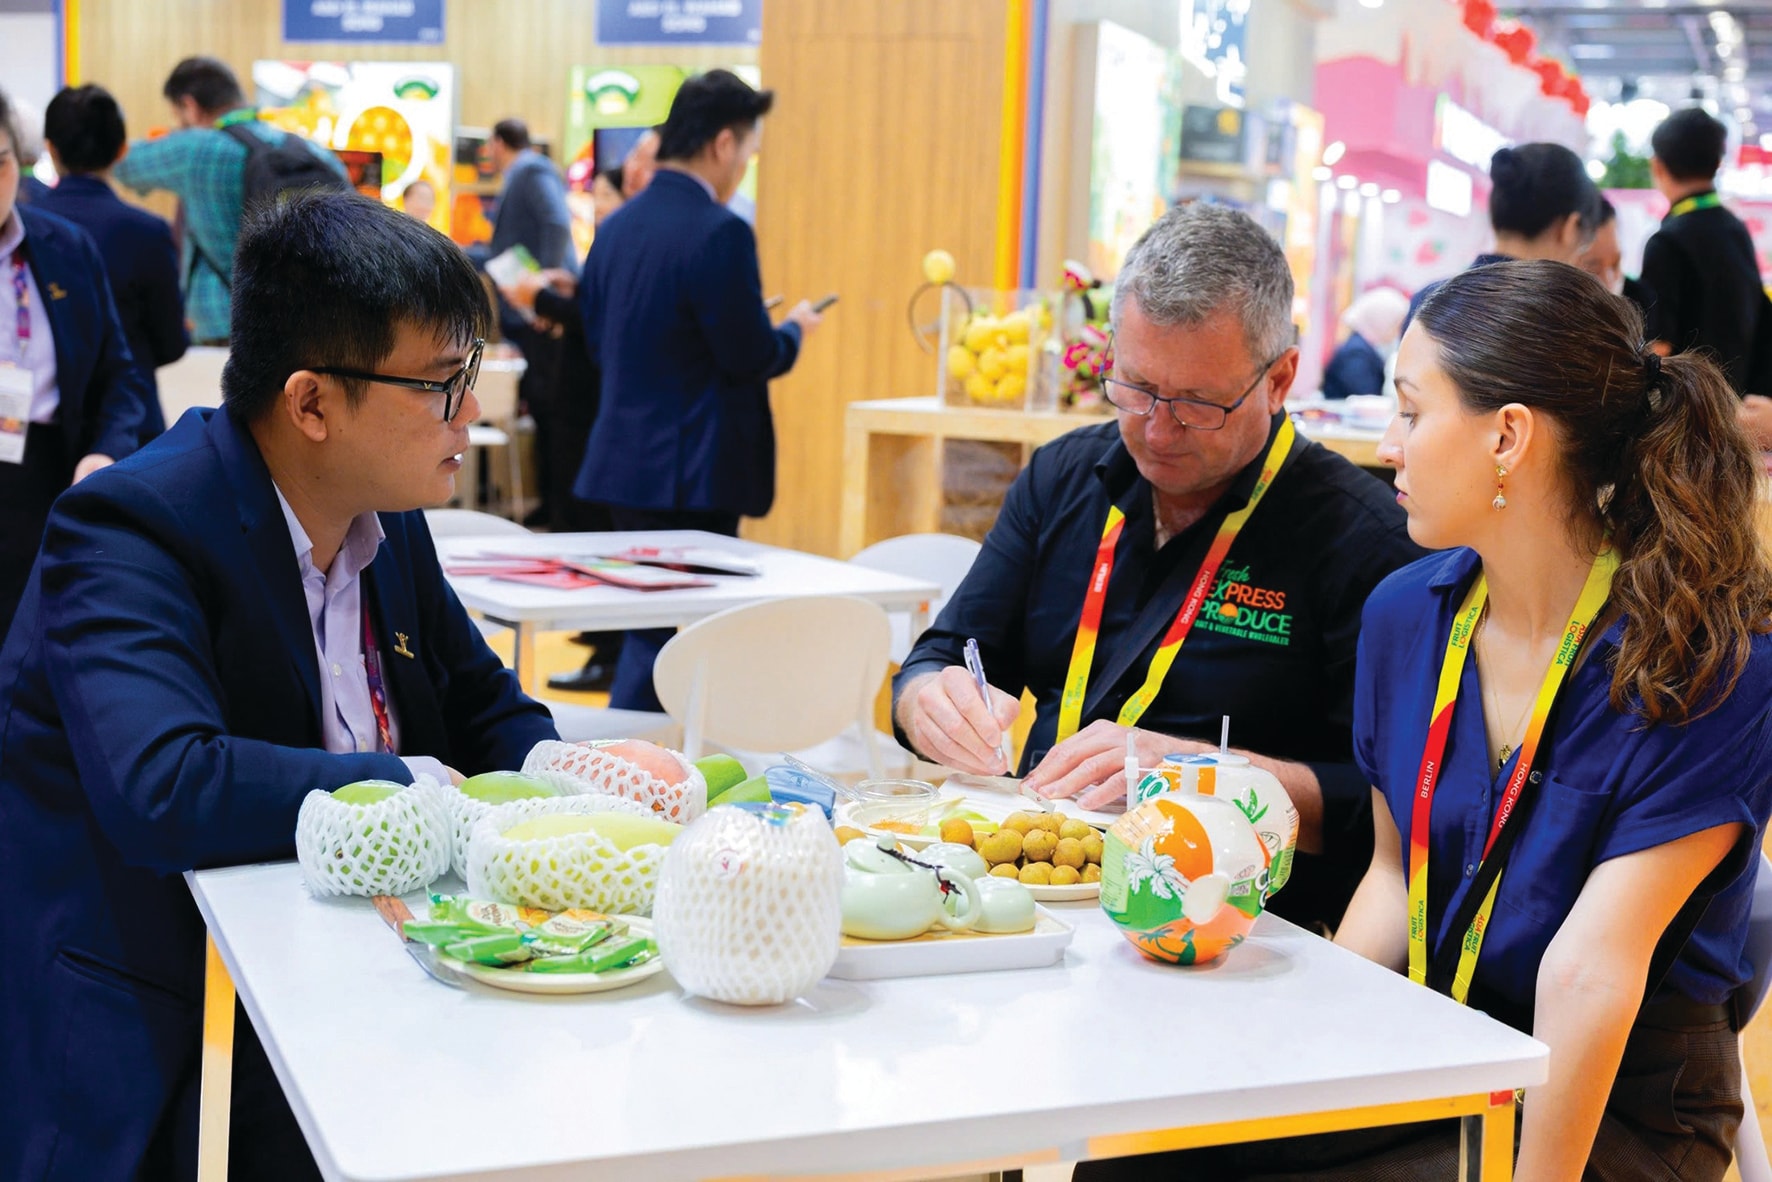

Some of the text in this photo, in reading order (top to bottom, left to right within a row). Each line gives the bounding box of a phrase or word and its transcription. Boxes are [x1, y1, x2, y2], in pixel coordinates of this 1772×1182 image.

[1451, 621, 1463, 647] FRUIT
[1458, 606, 1479, 649] LOGISTICA
[1556, 620, 1581, 665] LOGISTICA
[1574, 623, 1587, 643] ASIA
[1420, 760, 1435, 799] BERLIN
[1498, 762, 1528, 829] HONG KONG
[1471, 913, 1485, 955] ASIA FRUIT
